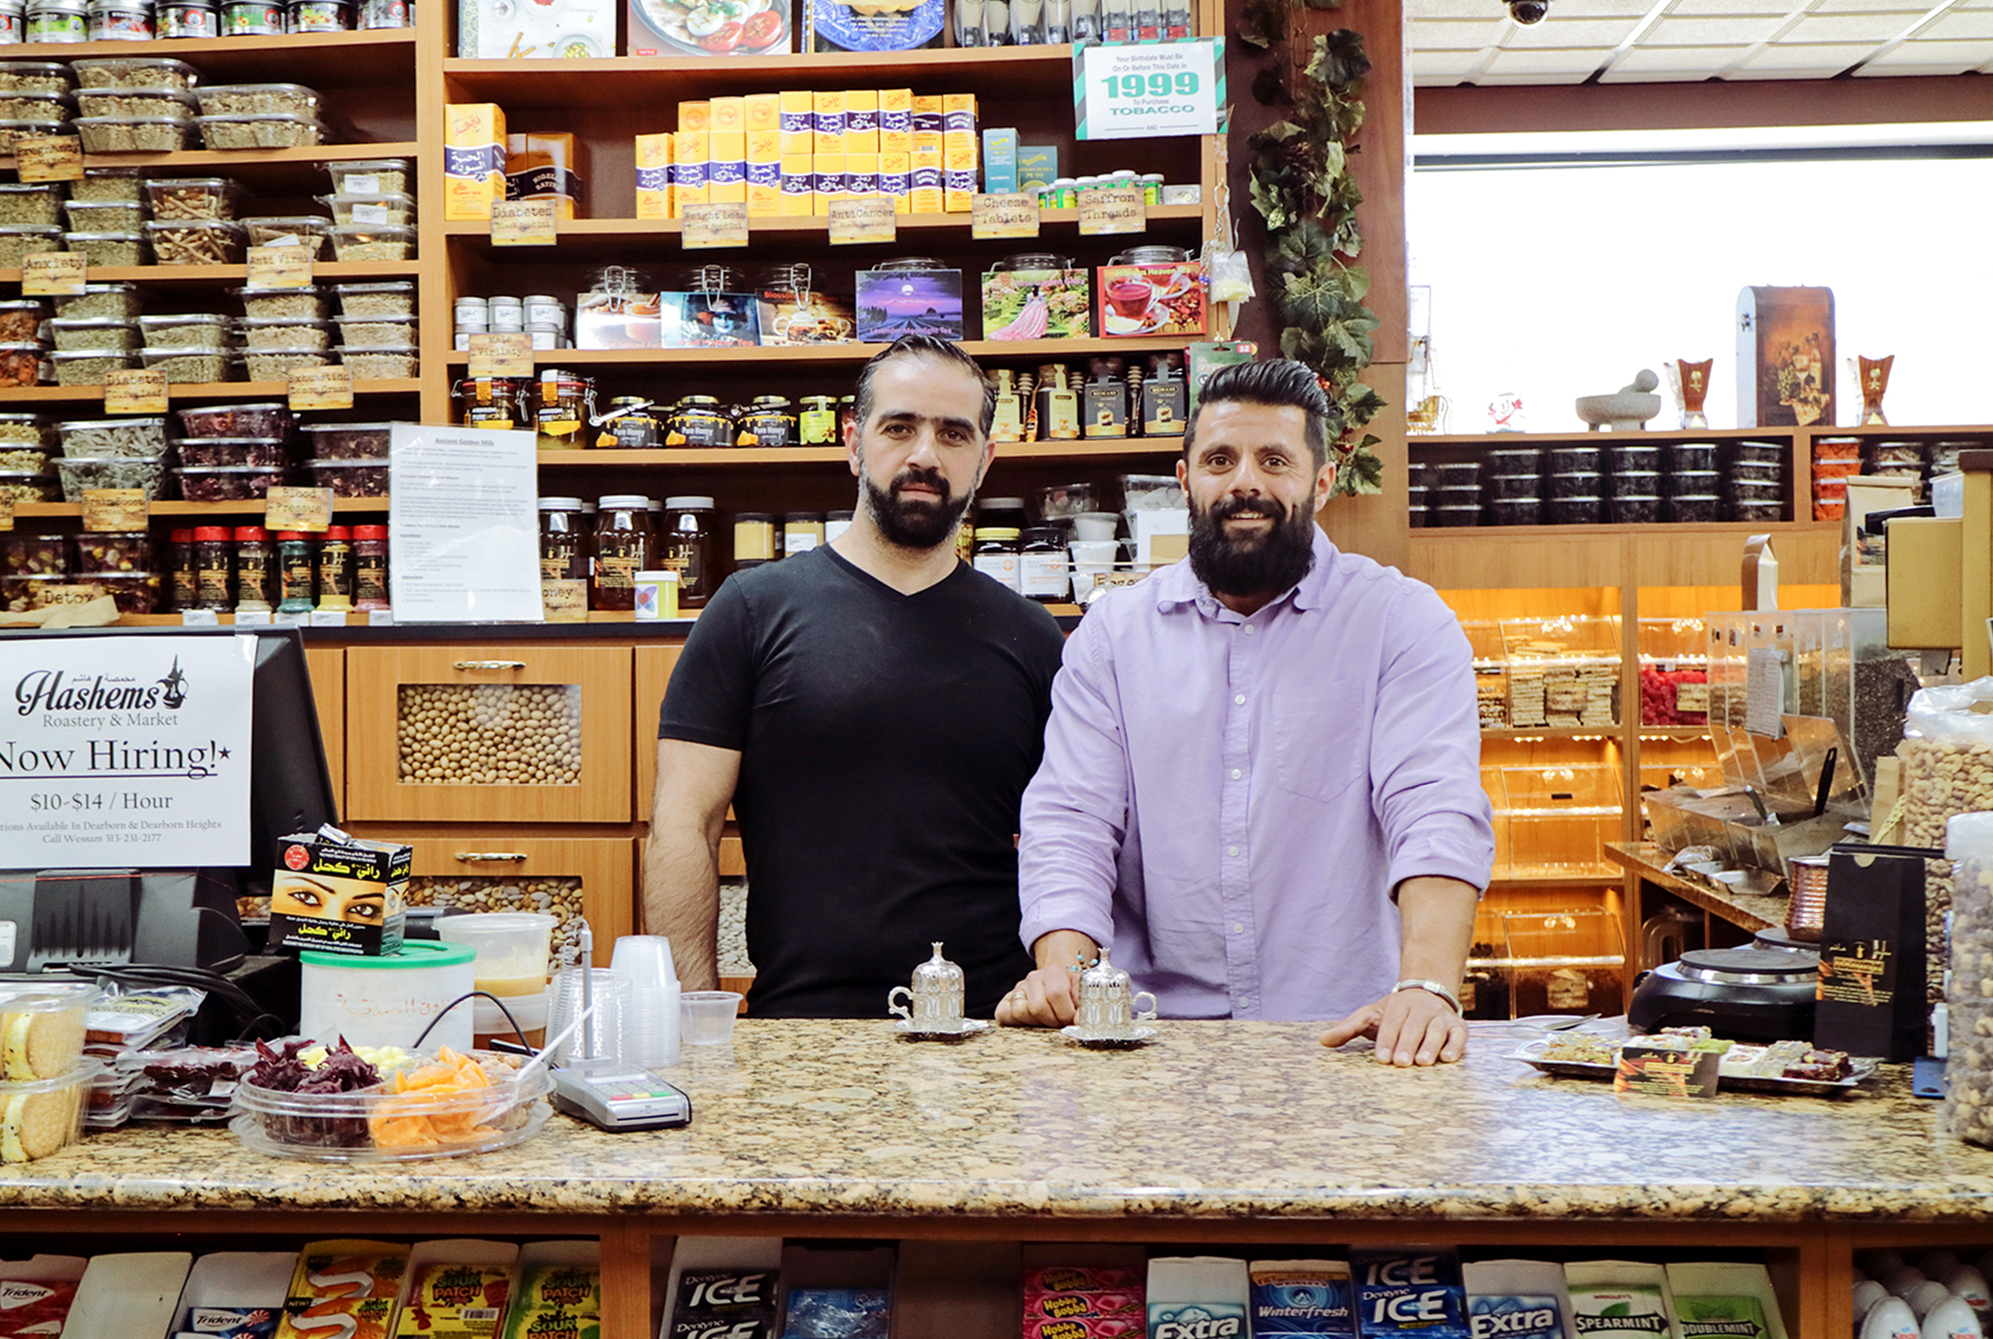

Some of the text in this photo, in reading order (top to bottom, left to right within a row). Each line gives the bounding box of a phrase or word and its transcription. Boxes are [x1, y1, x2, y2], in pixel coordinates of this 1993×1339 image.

[1131, 54, 1158, 62] Birthdate
[1159, 53, 1174, 61] Must
[1131, 64, 1152, 72] Before
[1166, 62, 1180, 70] Date
[1101, 71, 1200, 98] 1999
[1109, 104, 1196, 116] TOBACCO
[983, 197, 1029, 208] Cheese
[1085, 193, 1135, 204] Saffron
[492, 206, 553, 218] Diabetes
[684, 210, 746, 221] Weight Loss
[831, 208, 894, 219] AntiCancer
[982, 212, 1032, 224] Tablets
[1085, 208, 1137, 220] Threads
[23, 258, 85, 270] Anxiety
[1148, 267, 1177, 276] Heaven
[737, 338, 755, 347] Tea
[106, 373, 166, 386] Diabetes
[613, 427, 646, 441] Pure Honey
[681, 426, 714, 441] Pure Honey
[753, 425, 785, 440] Pure Honey
[434, 437, 458, 445] Ancient
[282, 487, 317, 499] Blood
[44, 589, 95, 604] Detox
[543, 587, 574, 600] oney
[15, 669, 160, 716] Hashems
[43, 712, 179, 731] Roastery & Market
[86, 739, 217, 780] Hiring!
[30, 791, 173, 814] $10-$14 / Hour
[26, 821, 69, 832] Available
[71, 821, 82, 831] In
[83, 820, 126, 831] Dearborn
[128, 820, 139, 831] &
[140, 819, 184, 831] Dearborn
[186, 818, 222, 831] Heights
[42, 832, 162, 844] Call Wessam 313-231-2177
[1366, 1256, 1440, 1287] ICE
[437, 1273, 482, 1289] SOUR
[1, 1287, 48, 1299] Trident
[432, 1286, 483, 1300] PATCH
[542, 1287, 591, 1300] PATCH
[688, 1273, 767, 1308] ICE
[1362, 1287, 1411, 1300] Dentyne
[1054, 1304, 1088, 1318] Bubba
[1258, 1305, 1349, 1320] Winterfresh
[1373, 1290, 1448, 1324] ICE
[195, 1314, 243, 1325] Trident
[530, 1319, 577, 1332] SOUR
[676, 1319, 725, 1333] Dentyne
[1470, 1308, 1554, 1339] Extra
[1576, 1315, 1661, 1331] SPEARMINT
[1155, 1317, 1240, 1339] Extra
[1682, 1322, 1755, 1335] DOUBLEMINT
